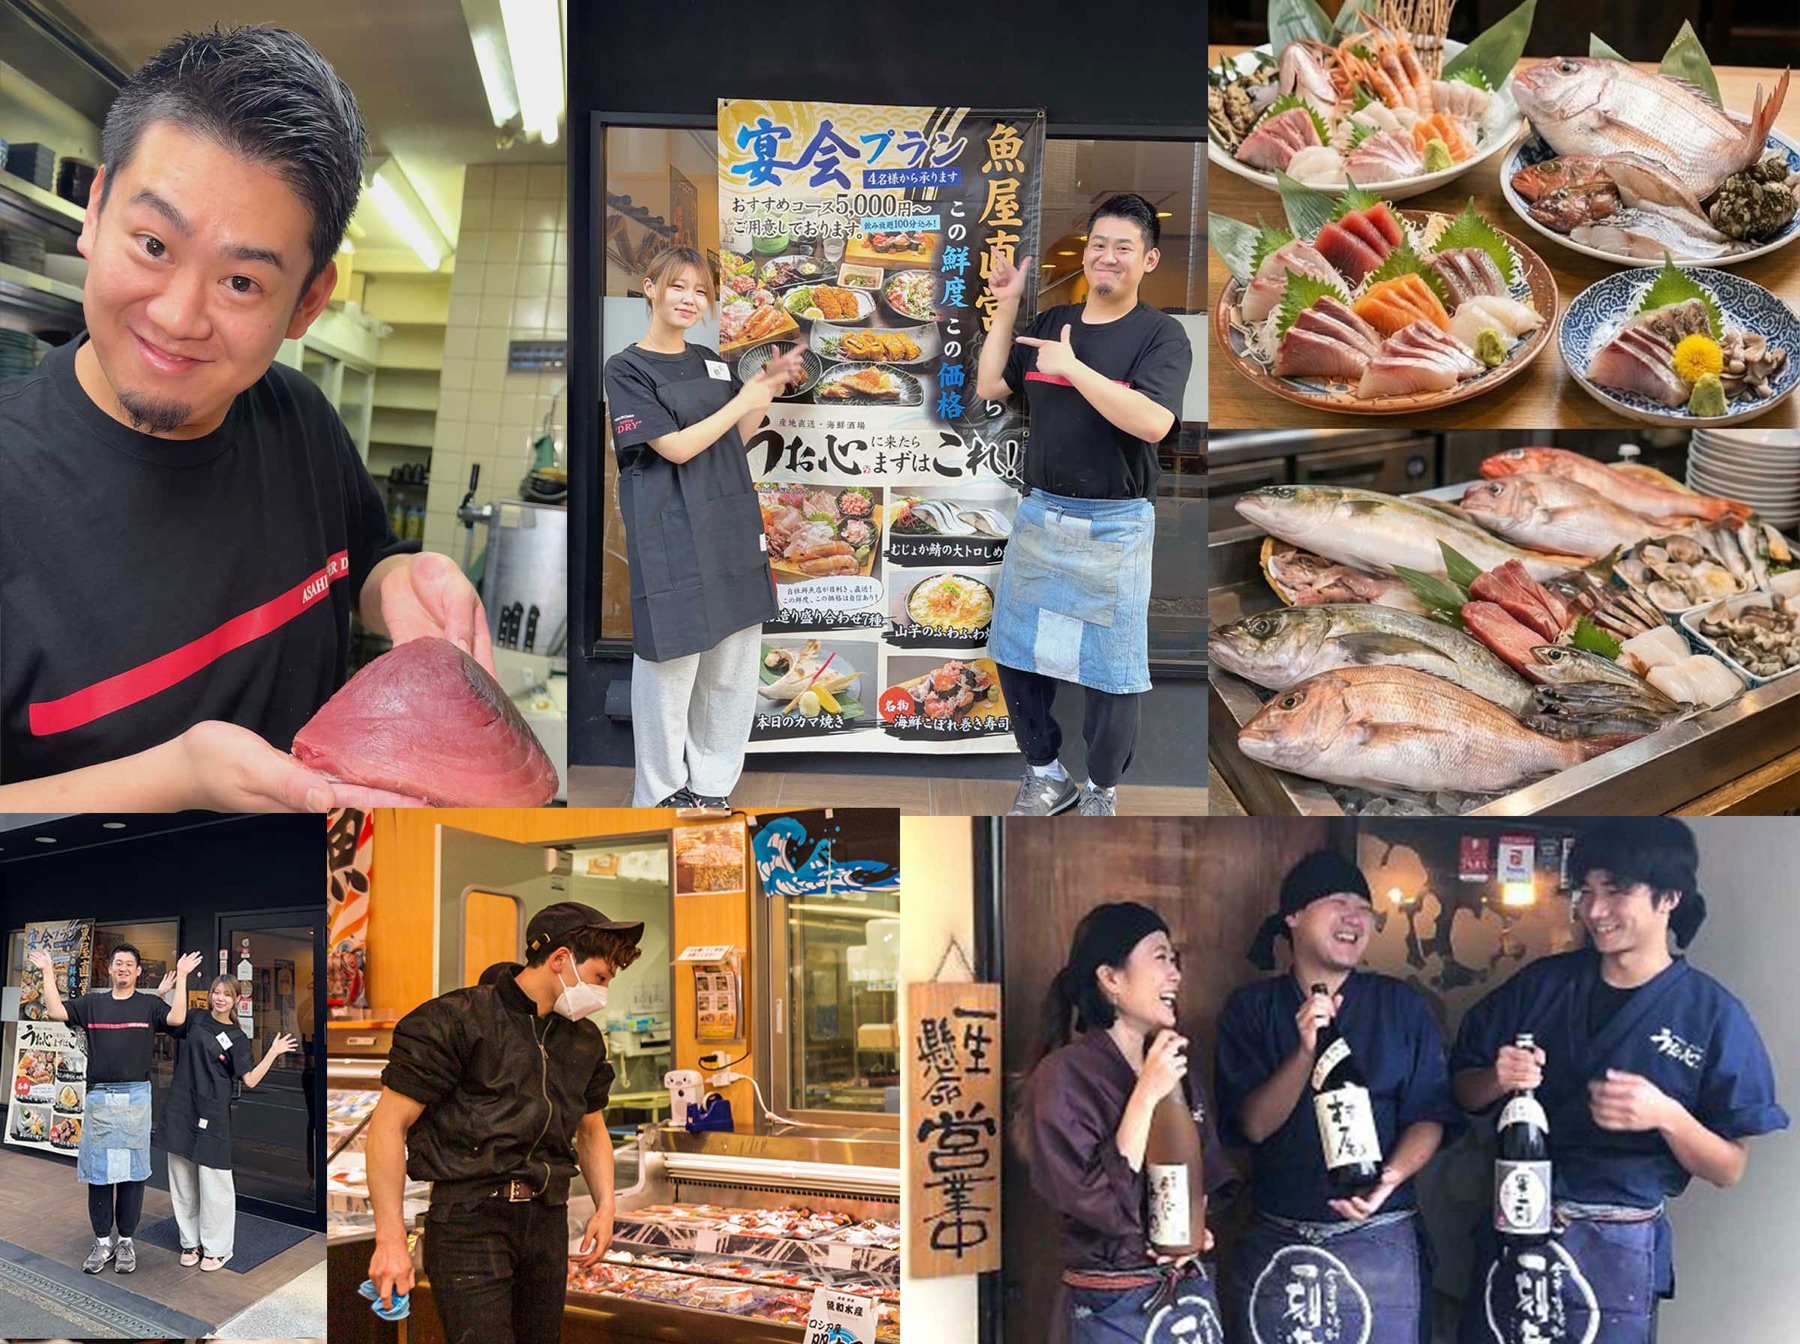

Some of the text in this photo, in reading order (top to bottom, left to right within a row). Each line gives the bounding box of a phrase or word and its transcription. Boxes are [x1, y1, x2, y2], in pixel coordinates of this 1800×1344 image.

[731, 118, 967, 190] 宴会プラン
[867, 171, 959, 185] 4名様から承ります
[733, 218, 864, 240] ご用意しております。
[778, 418, 866, 430] 産地直送・海鮮酒場
[871, 435, 921, 449] に来たら
[890, 543, 1007, 559] むじょか鯖の大トロしめ
[302, 575, 329, 604] ASAHI
[766, 608, 884, 628] 造り盛り合わせ7種
[883, 699, 910, 713] 名物
[756, 714, 845, 730] 本日のカマ焼き
[894, 715, 1010, 732] 海鮮こぼれ巻き寿司
[917, 1102, 997, 1258] 営業中
